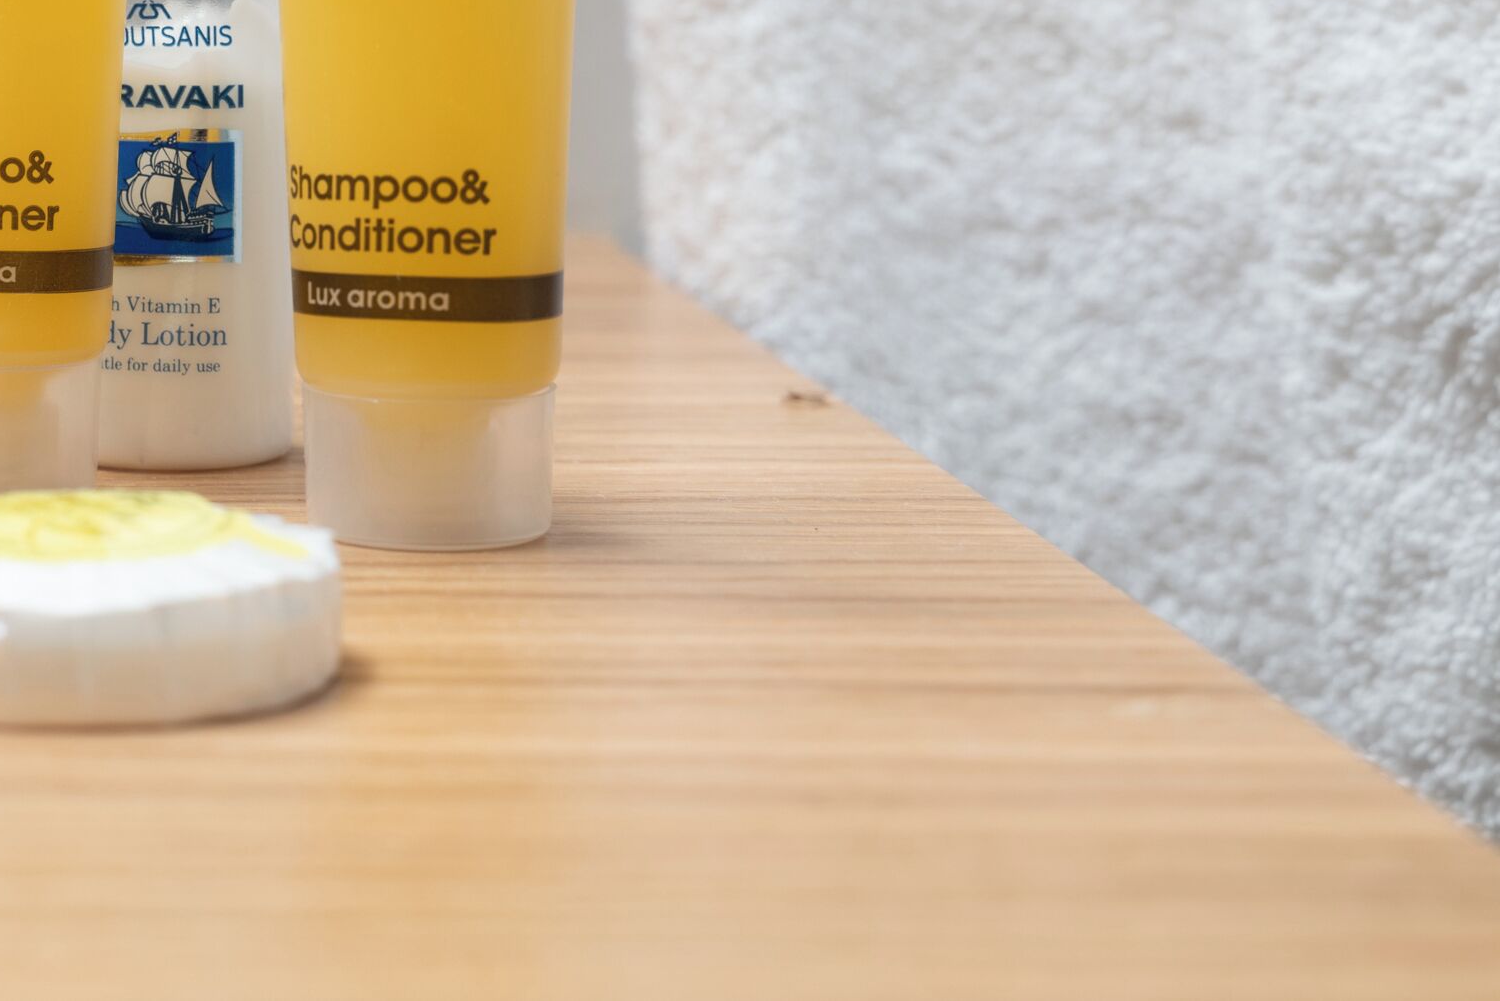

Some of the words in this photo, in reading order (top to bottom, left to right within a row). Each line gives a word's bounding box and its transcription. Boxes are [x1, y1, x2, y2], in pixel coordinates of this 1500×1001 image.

[120, 83, 245, 110] RAVAKI
[290, 164, 491, 210] Shampoo&
[290, 214, 498, 257] Conditioner
[126, 294, 202, 315] Vitamin
[208, 296, 221, 315] E
[307, 280, 342, 307] Lux
[347, 288, 450, 312] aroma
[140, 320, 228, 347] Lotion
[126, 356, 149, 372] for
[152, 358, 192, 377] daily
[196, 360, 221, 373] use
